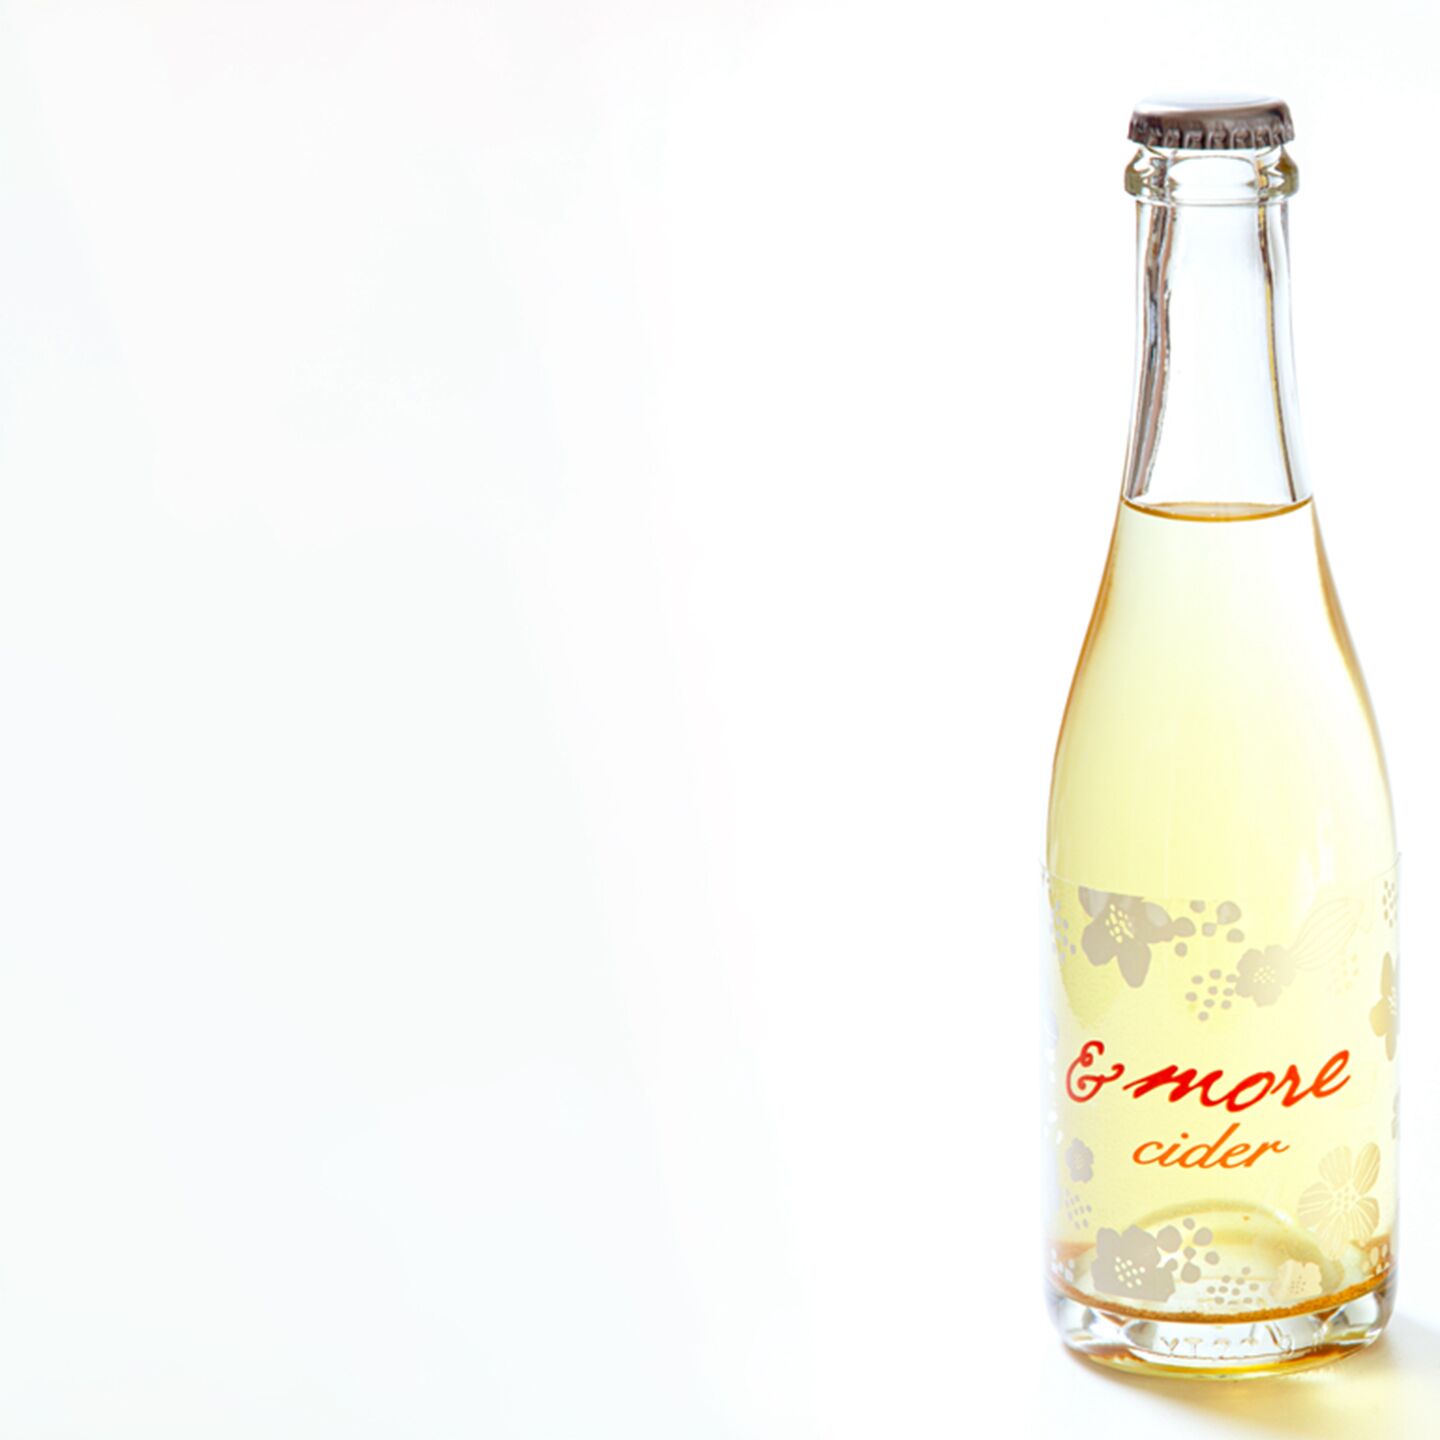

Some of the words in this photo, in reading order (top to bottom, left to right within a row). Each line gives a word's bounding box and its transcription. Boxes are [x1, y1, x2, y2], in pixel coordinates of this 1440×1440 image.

[1065, 1039, 1126, 1104] &
[1122, 1049, 1352, 1114] more
[1131, 1122, 1289, 1169] cider
